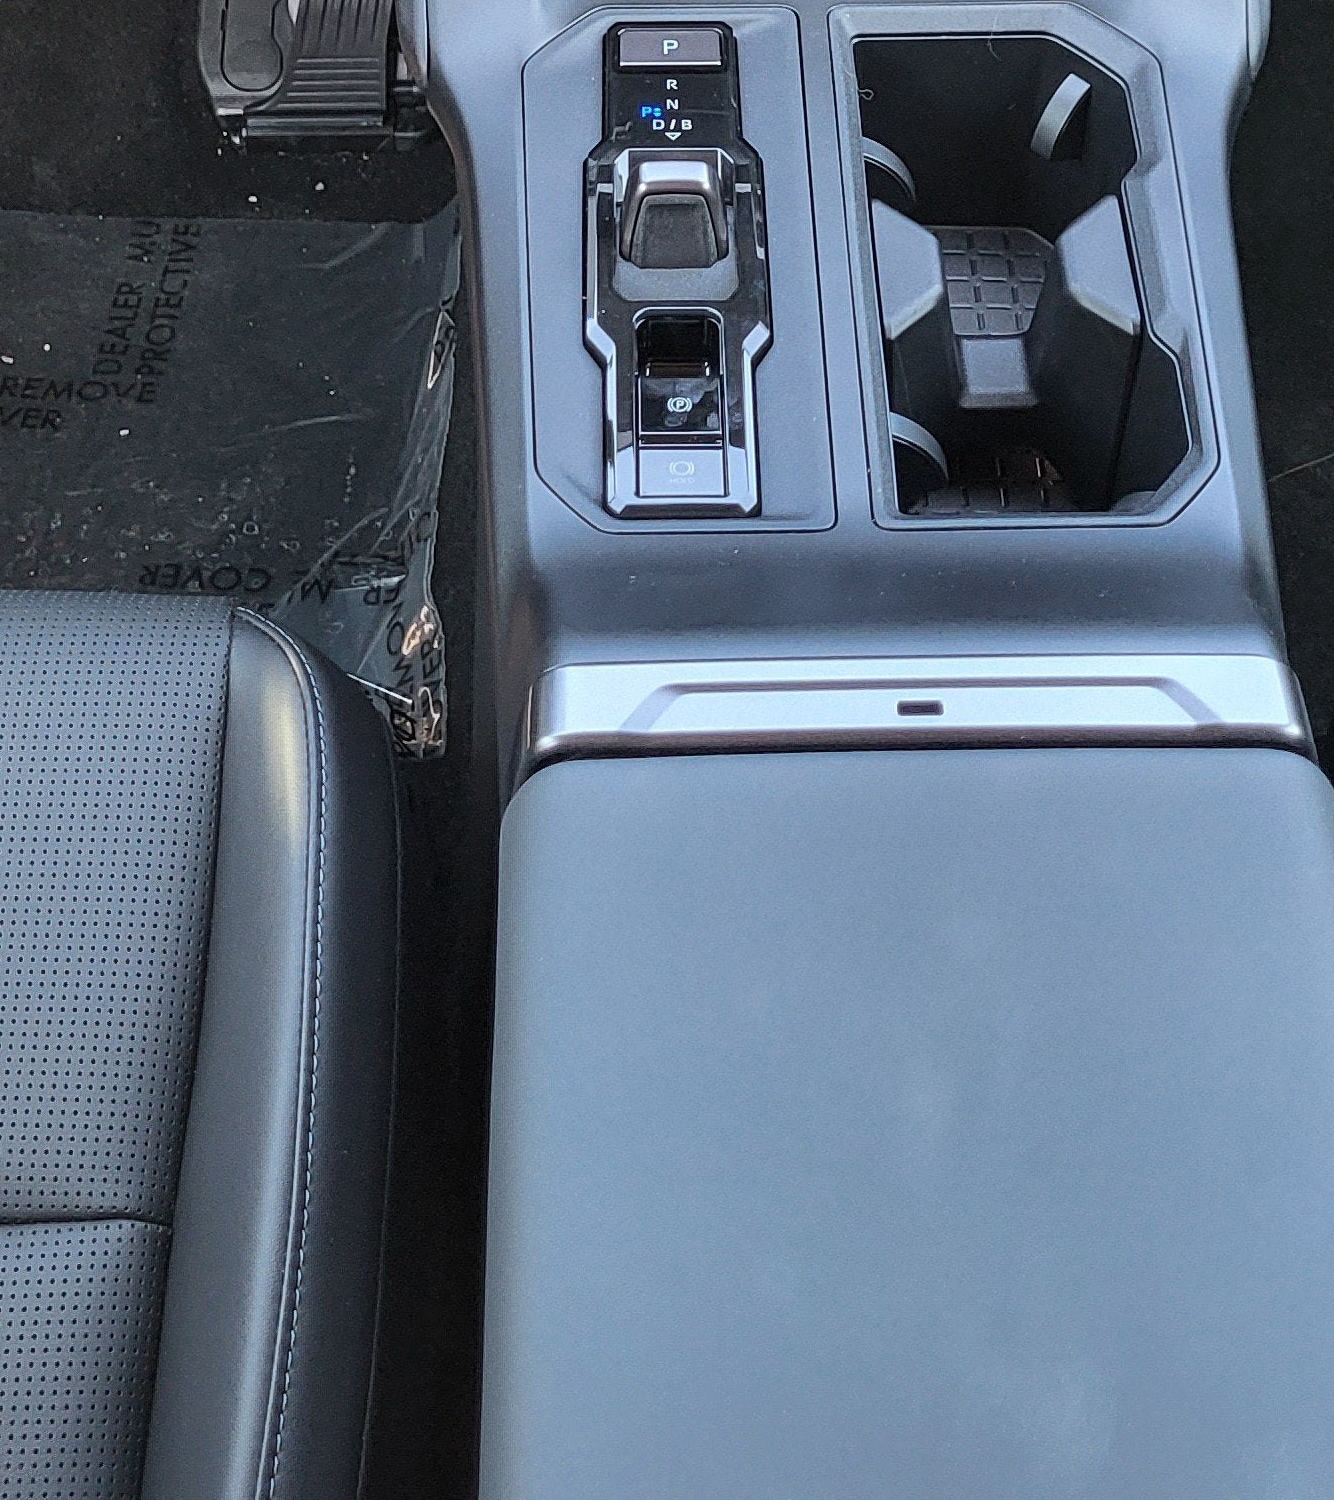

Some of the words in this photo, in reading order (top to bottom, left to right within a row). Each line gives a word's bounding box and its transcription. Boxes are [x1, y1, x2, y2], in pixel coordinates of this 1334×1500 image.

[663, 39, 679, 55] P
[666, 79, 678, 90] R
[666, 99, 679, 110] N
[134, 222, 201, 377] PROTECTIVE
[92, 281, 146, 376] DEALER
[139, 562, 271, 593] COVER
